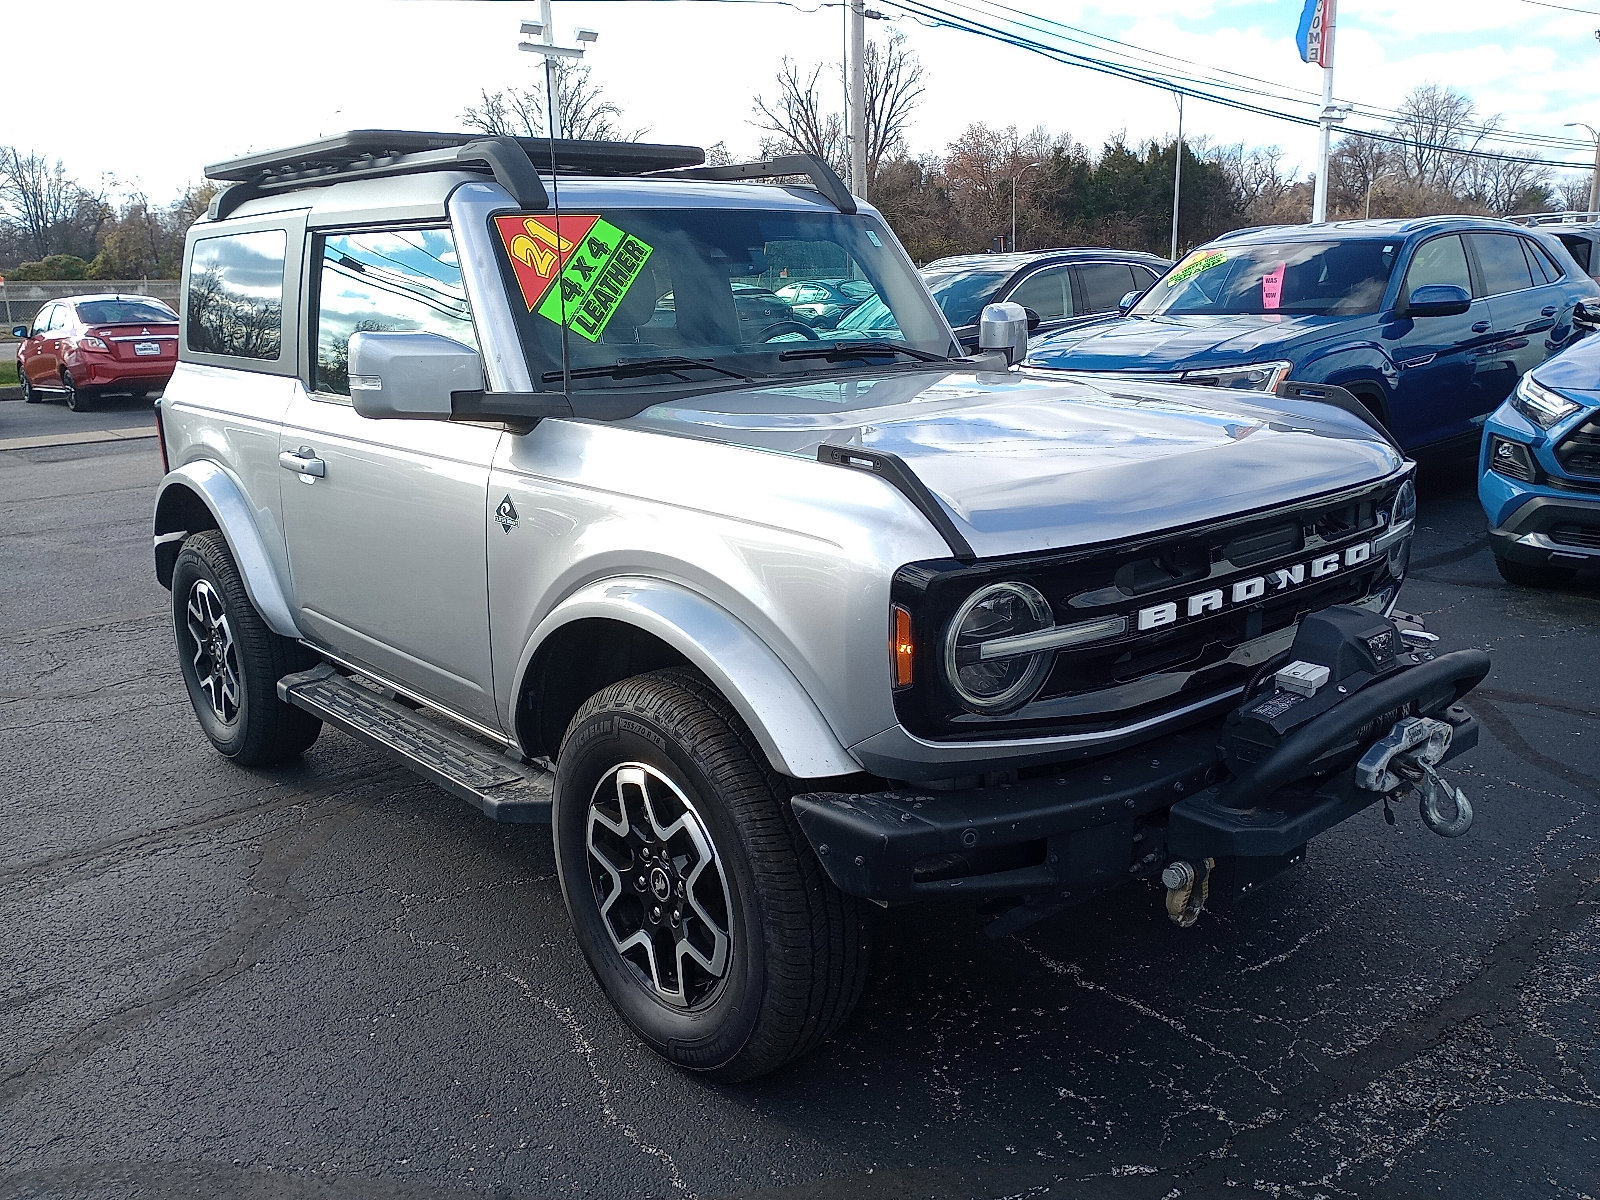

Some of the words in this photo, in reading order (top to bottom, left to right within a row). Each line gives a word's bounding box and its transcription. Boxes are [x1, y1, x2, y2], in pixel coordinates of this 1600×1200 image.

[511, 218, 574, 279] 21
[561, 276, 586, 302] 4
[587, 236, 613, 260] 4
[575, 239, 648, 336] LEATHER
[1138, 542, 1370, 631] BRONCO
